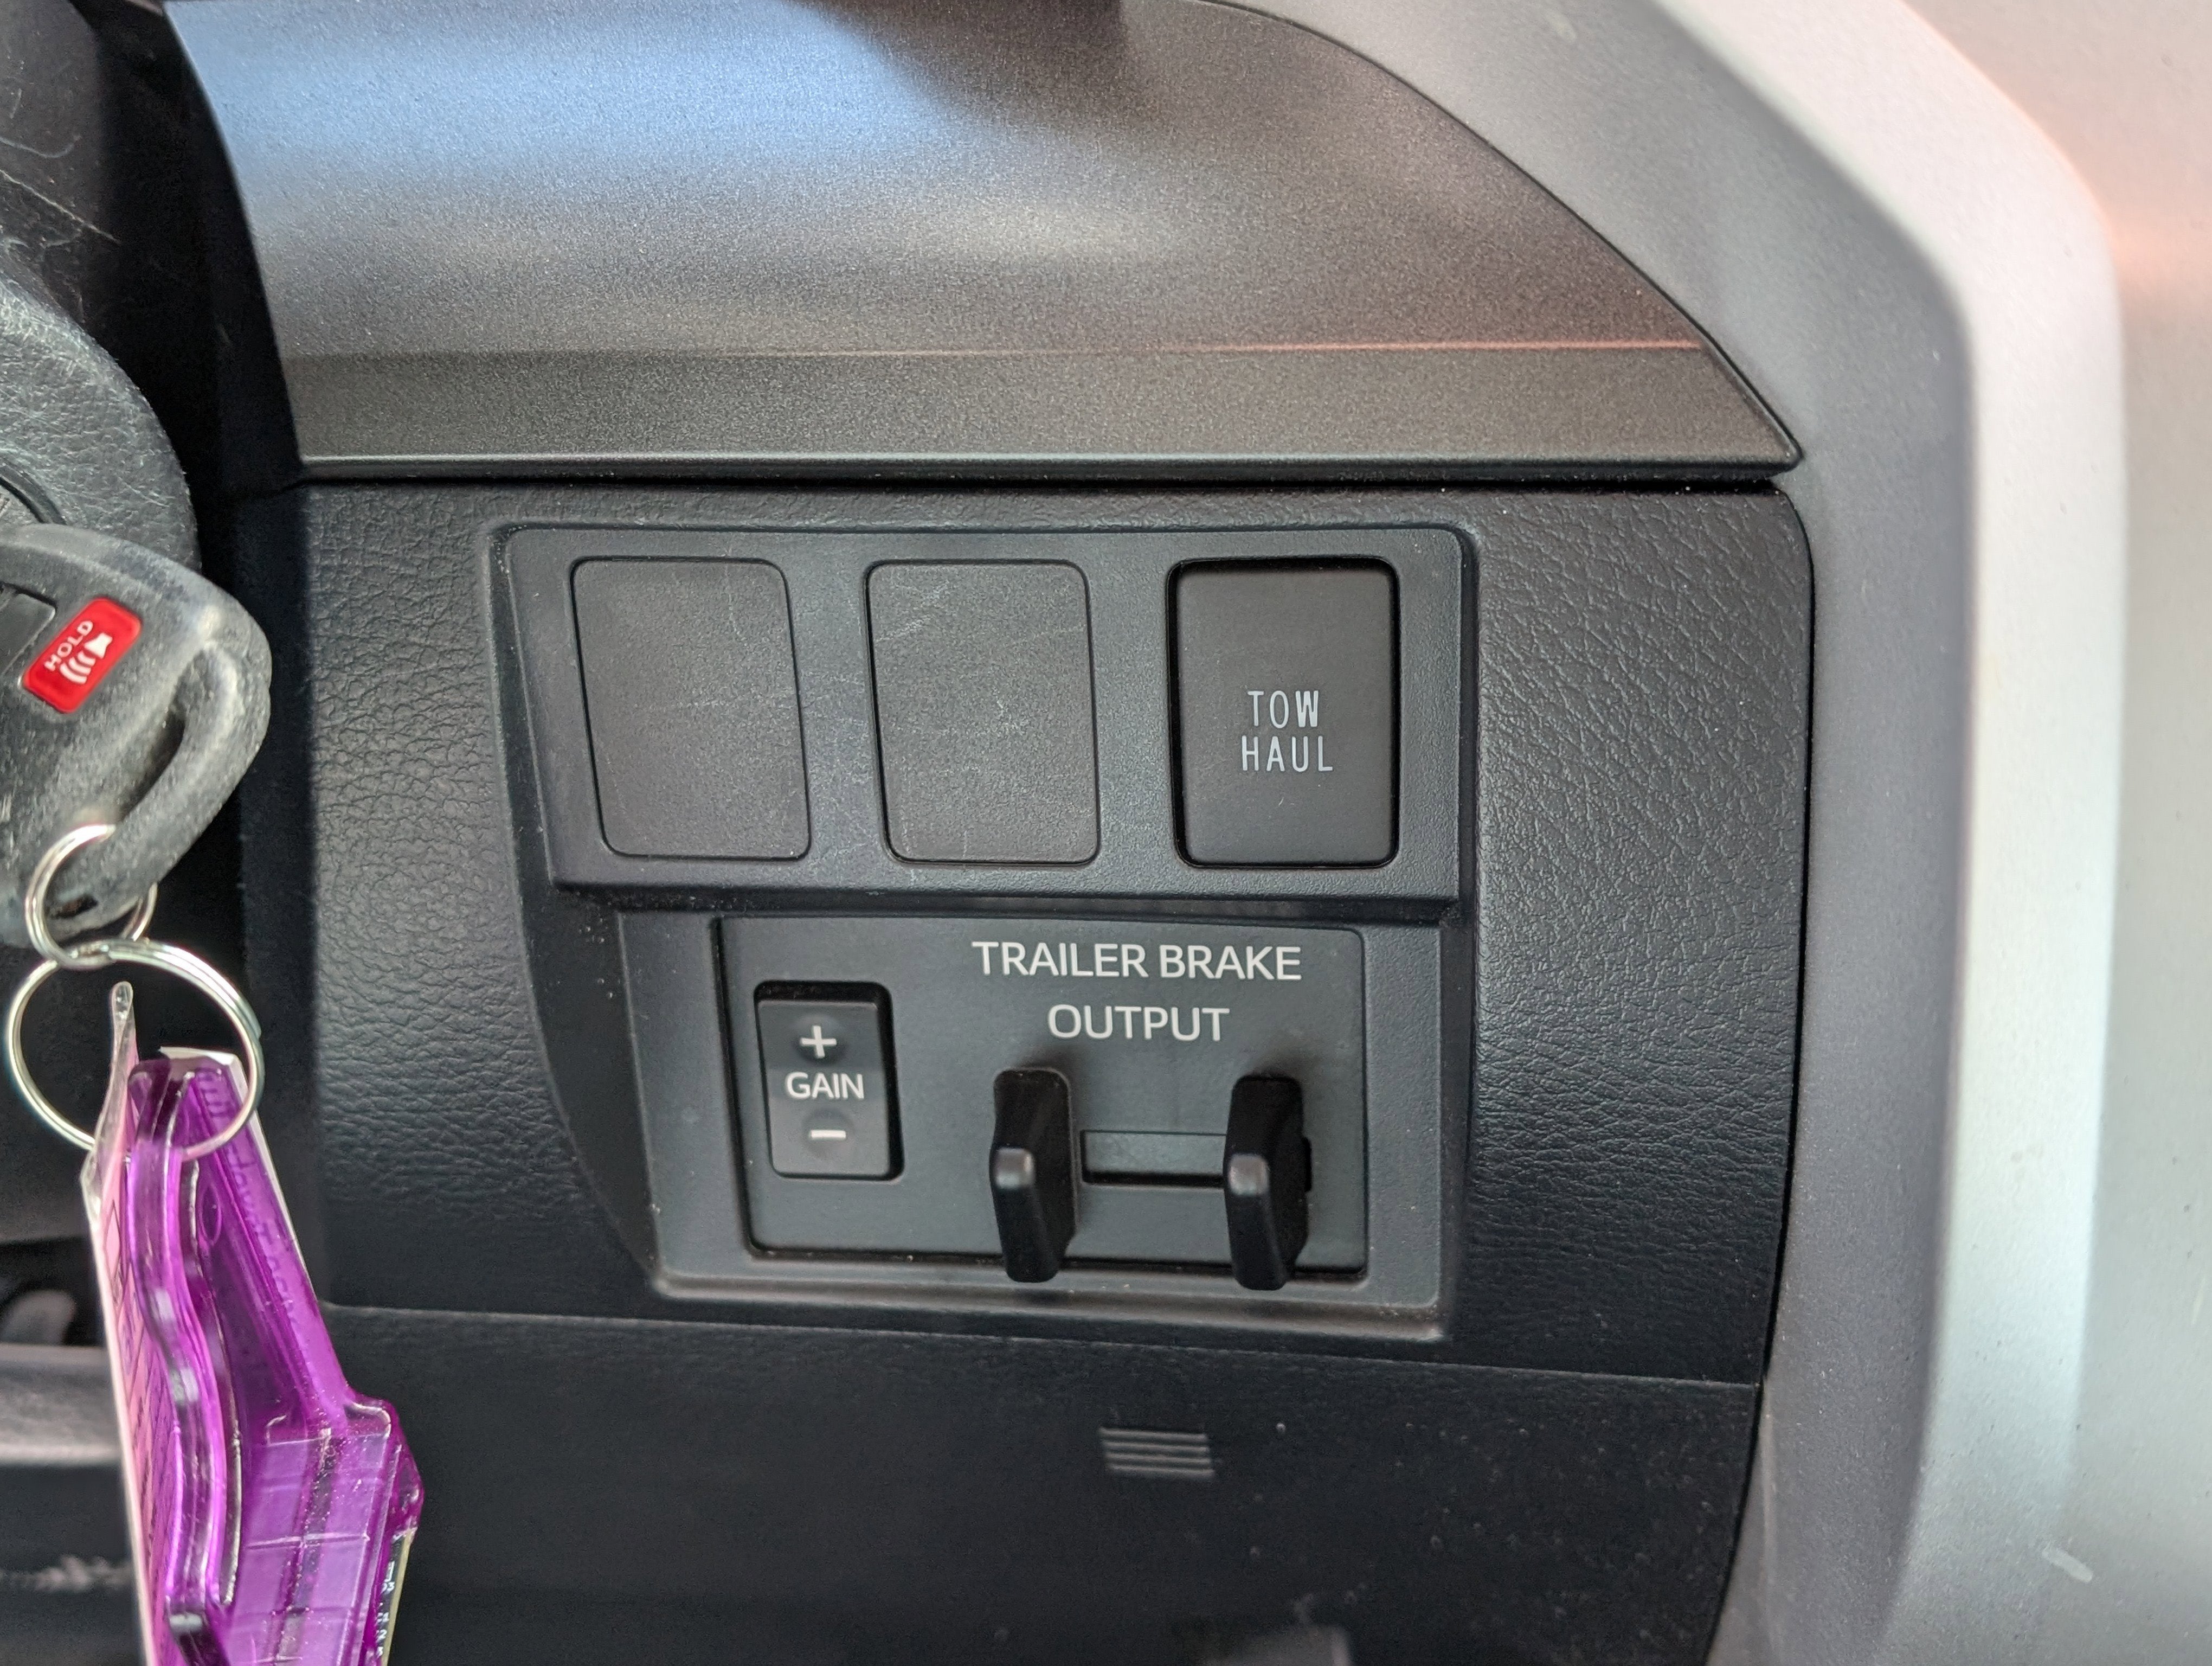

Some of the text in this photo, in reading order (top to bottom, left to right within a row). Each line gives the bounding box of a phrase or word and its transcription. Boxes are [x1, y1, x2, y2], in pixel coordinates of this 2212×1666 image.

[44, 620, 93, 671] HOLD
[1247, 690, 1319, 729] TOW
[1241, 735, 1333, 772] HAUL
[972, 941, 1302, 981] TRAILER BRAKE
[1048, 1004, 1230, 1041] OUTPUT
[786, 1072, 865, 1099] GAIN
